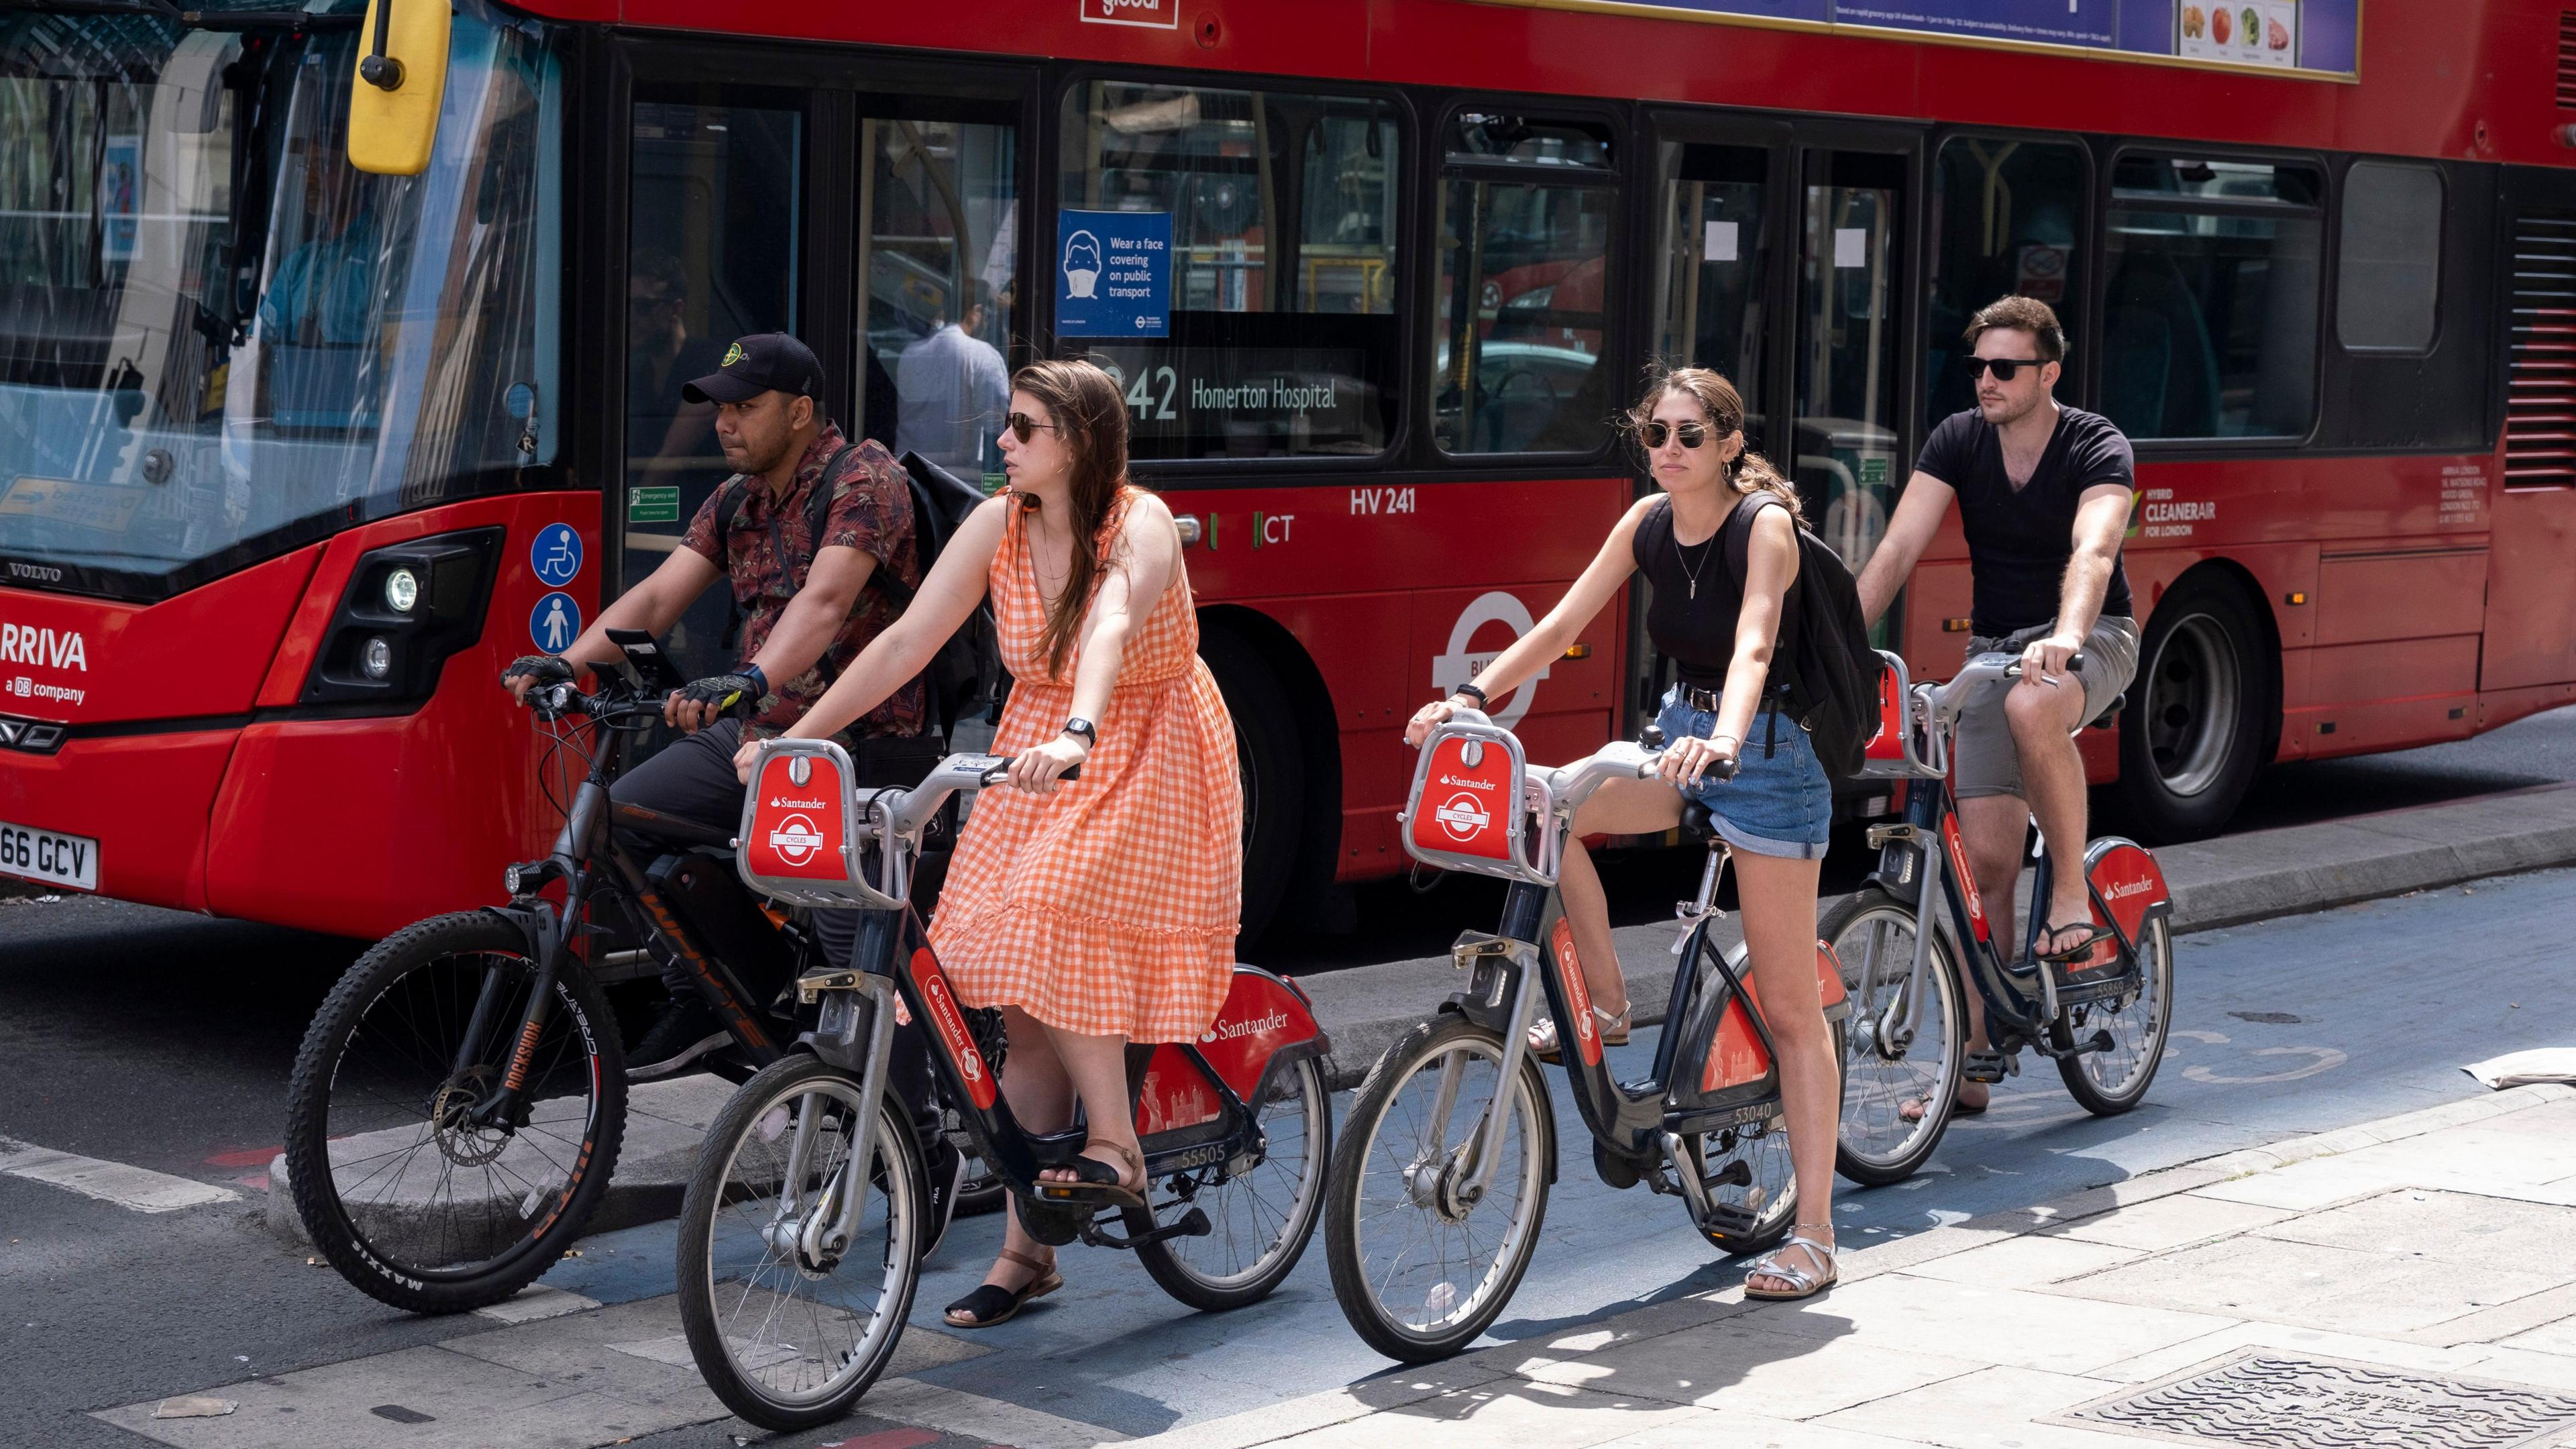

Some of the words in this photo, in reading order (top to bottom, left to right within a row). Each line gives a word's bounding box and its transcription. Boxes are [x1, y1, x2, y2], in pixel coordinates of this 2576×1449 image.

[1110, 237, 1134, 249] Wear
[1136, 240, 1141, 249] a
[1144, 238, 1163, 250] face
[1110, 254, 1148, 268] covering
[1110, 272, 1121, 281] on
[1124, 270, 1151, 283] public
[1109, 287, 1150, 299] transport
[1192, 378, 1267, 409] Homerton
[1273, 378, 1336, 417] Hospital
[1351, 488, 1382, 515] HV
[1385, 488, 1415, 514] 241
[2147, 488, 2173, 500] HYBRID
[1264, 515, 1294, 543] CT
[2145, 526, 2159, 537] FOR
[2161, 525, 2192, 537] LONDON
[9, 562, 61, 582] VOLVO
[6, 680, 12, 692] a
[16, 680, 30, 694] DB
[34, 683, 85, 706] company
[1450, 775, 1496, 791] Santander
[781, 797, 826, 809] Santander
[1452, 813, 1473, 821] CYCLES
[1, 828, 30, 867] 66
[38, 836, 85, 879] GCV
[2114, 874, 2153, 899] Santander
[1567, 959, 1585, 1009] Santander
[2098, 981, 2124, 998] 55869
[936, 993, 965, 1047] Santander
[1218, 1009, 1287, 1040] Santander
[504, 1020, 542, 1091] ROCKSHOX
[1734, 1102, 1772, 1125] 53040
[1181, 1144, 1226, 1169] 55505
[352, 1240, 423, 1291] MAXXIS
